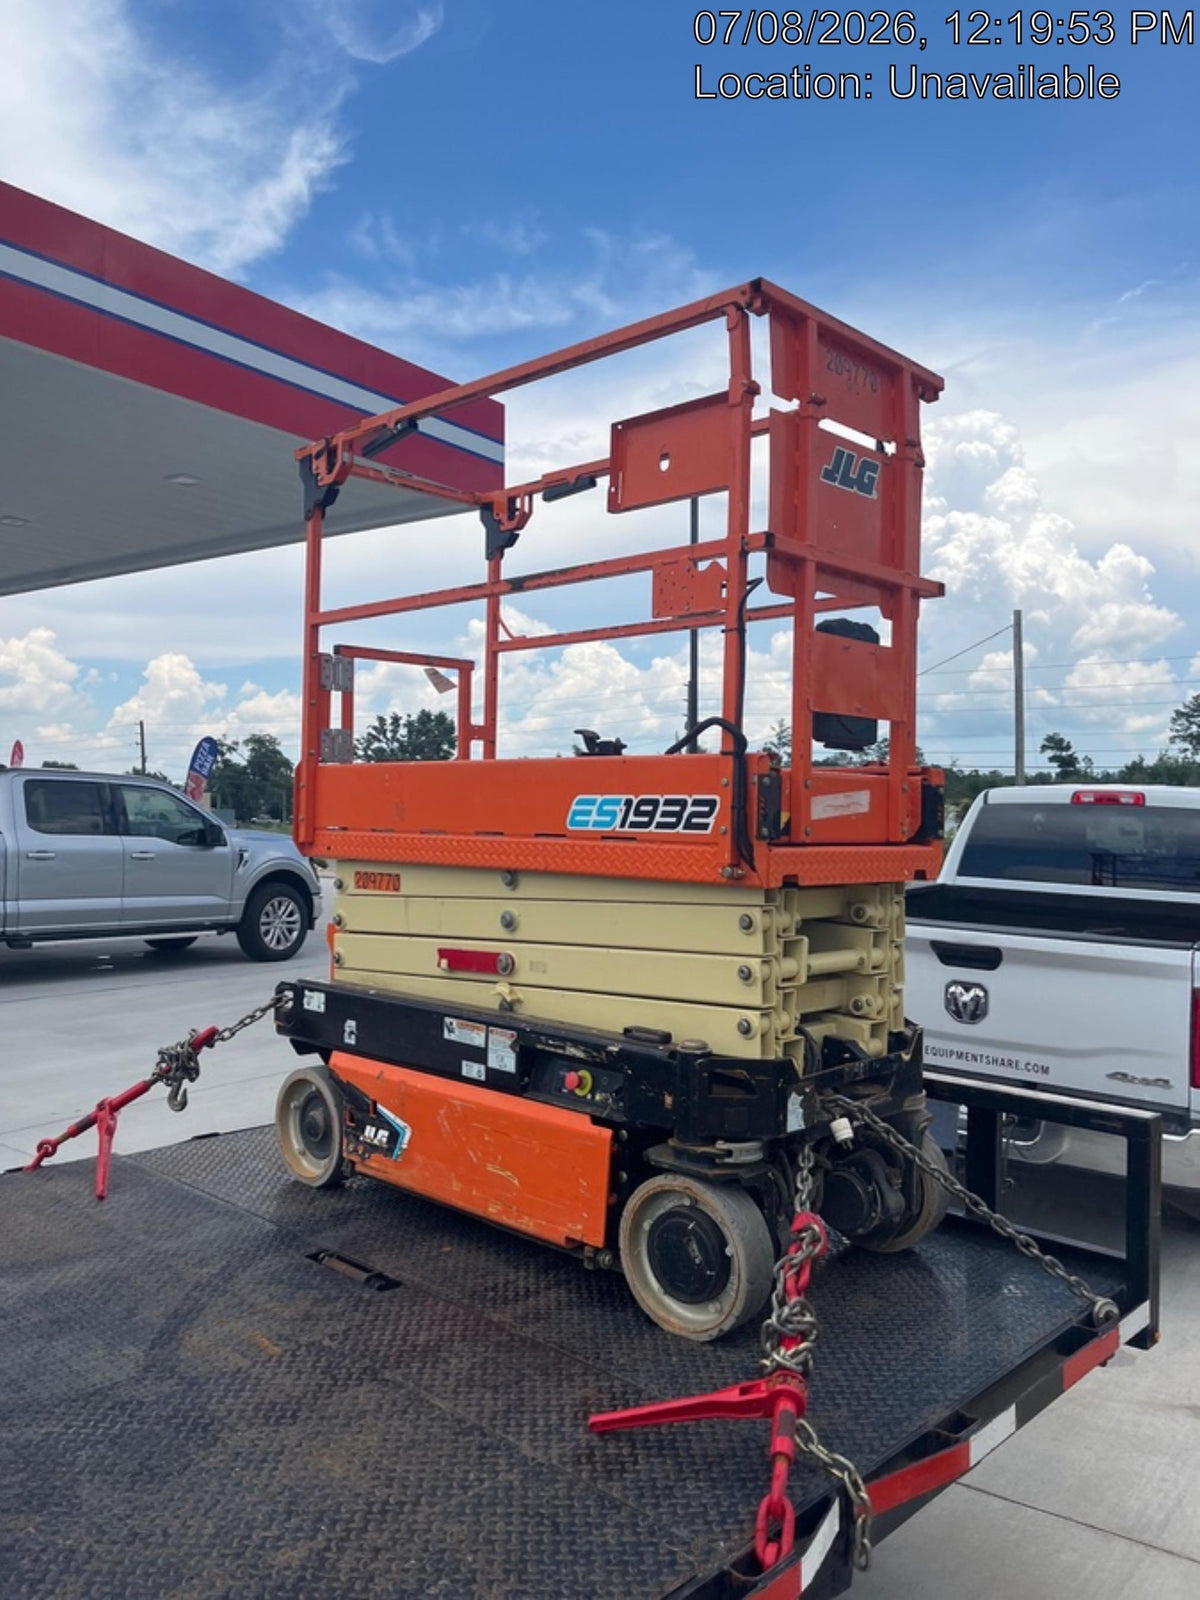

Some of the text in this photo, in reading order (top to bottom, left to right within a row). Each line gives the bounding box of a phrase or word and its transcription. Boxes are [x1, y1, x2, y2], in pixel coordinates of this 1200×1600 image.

[820, 446, 881, 500] JLG
[566, 794, 721, 834] ES1932
[924, 1044, 1050, 1076] EQUIPMENTSHARE.COM
